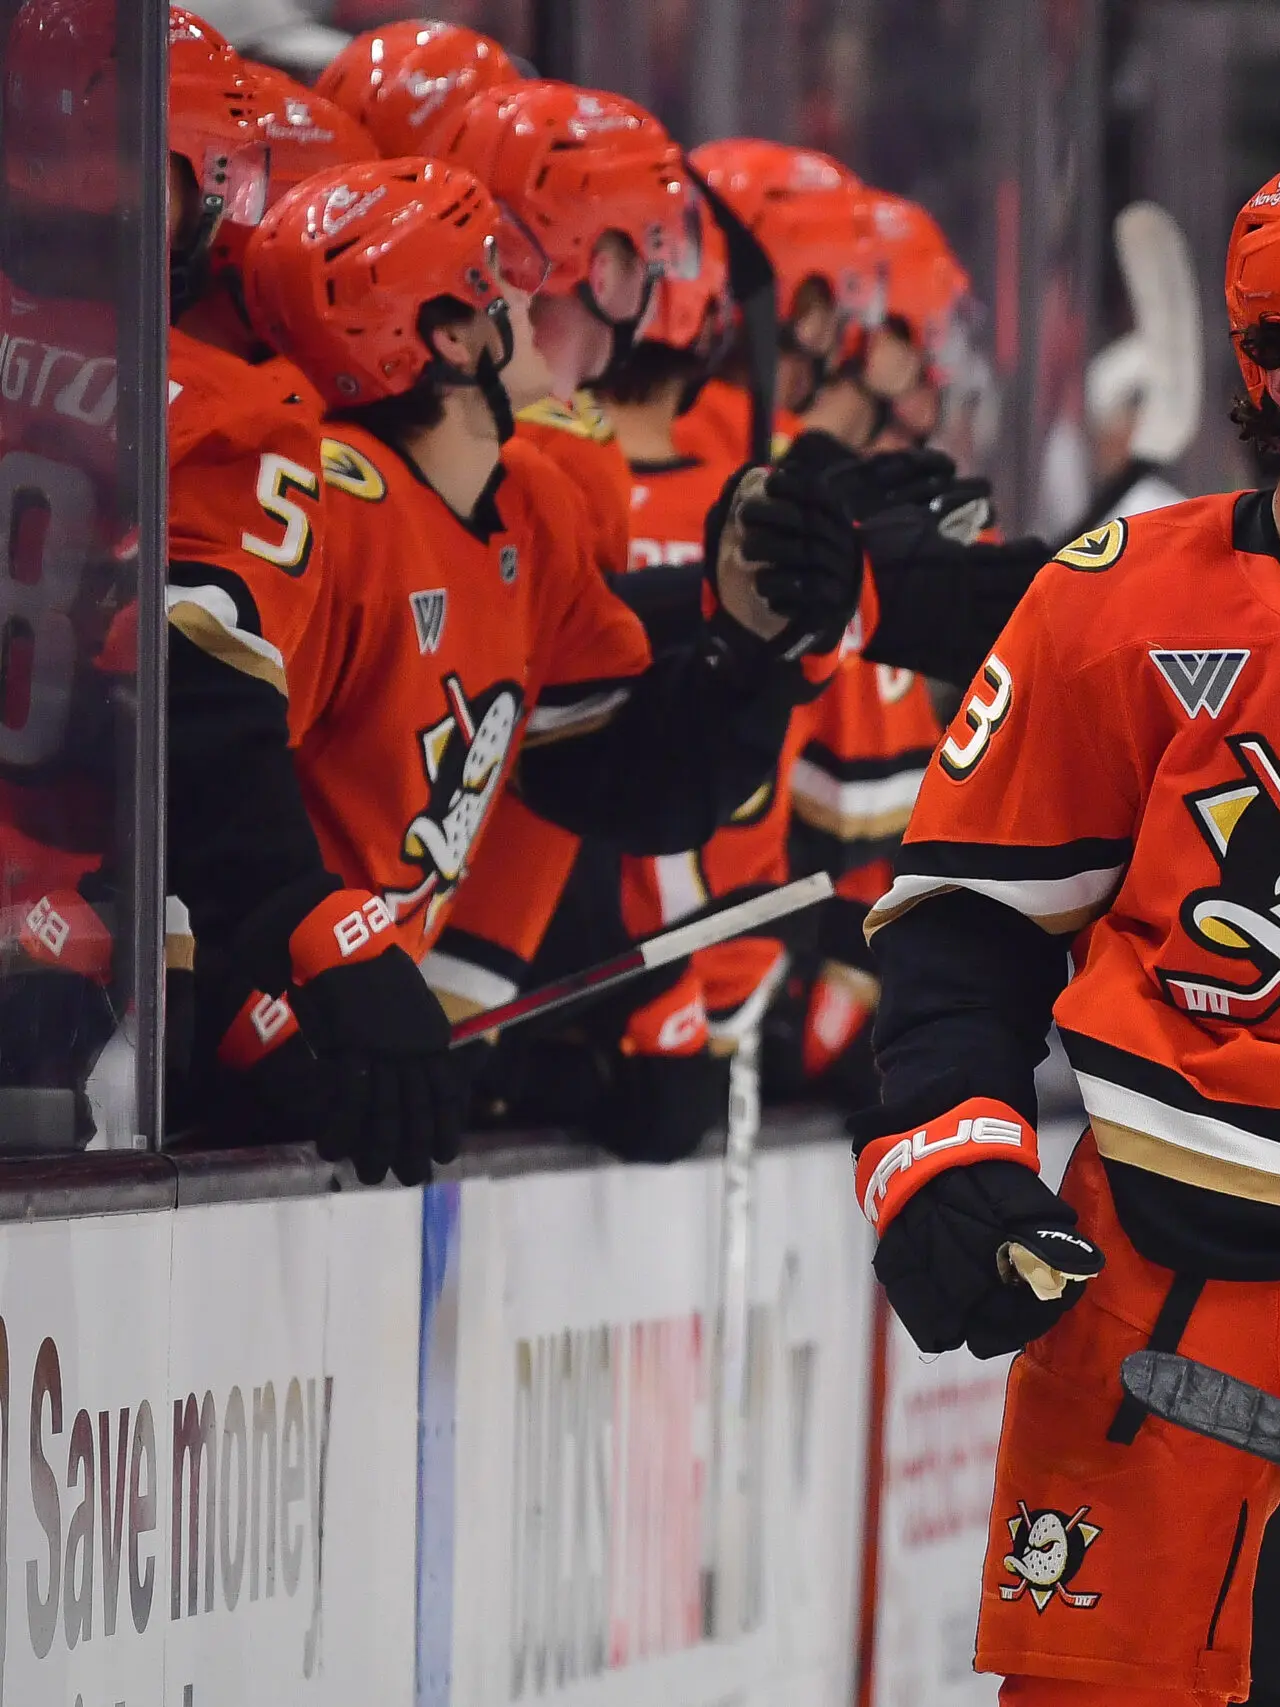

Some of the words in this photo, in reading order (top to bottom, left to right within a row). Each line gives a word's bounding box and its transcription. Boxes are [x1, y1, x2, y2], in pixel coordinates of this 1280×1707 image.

[241, 453, 319, 577] 5
[938, 653, 1014, 783] 3
[862, 1117, 1022, 1224] TRUE
[1036, 1230, 1094, 1253] TRUE
[26, 1337, 157, 1660] Save
[171, 1376, 334, 1680] money
